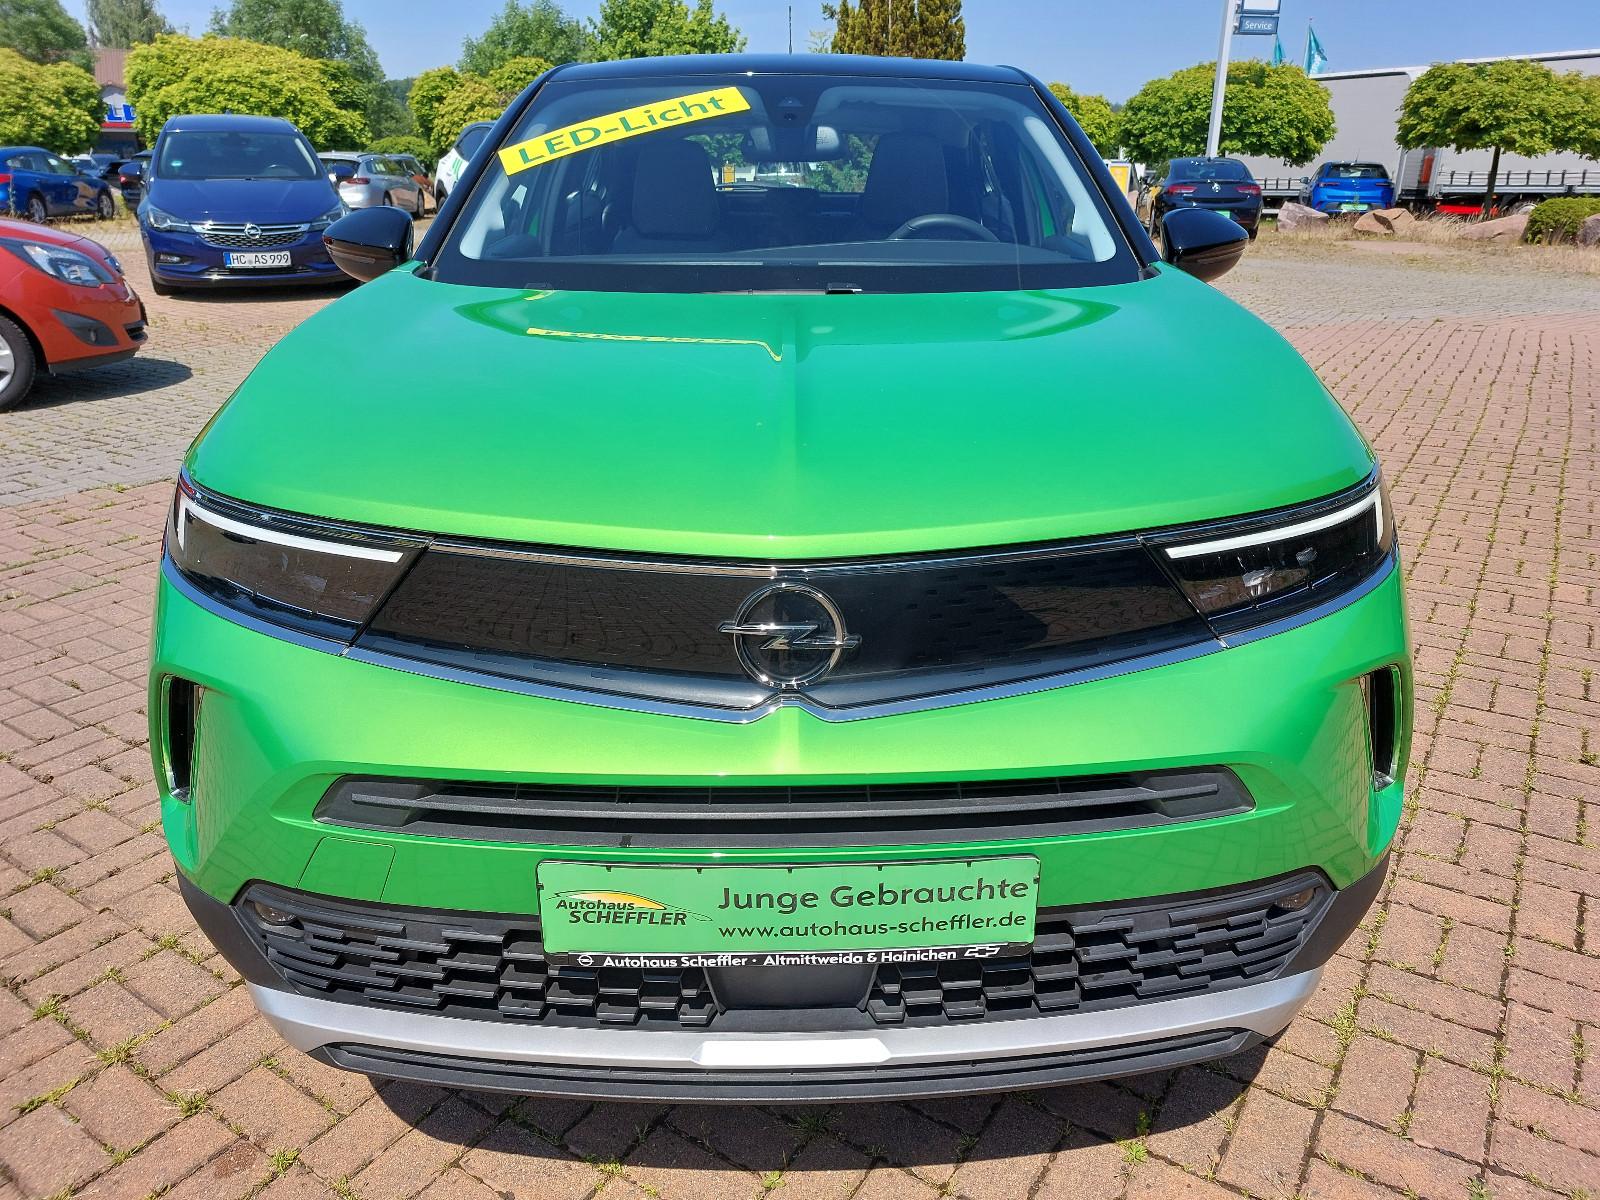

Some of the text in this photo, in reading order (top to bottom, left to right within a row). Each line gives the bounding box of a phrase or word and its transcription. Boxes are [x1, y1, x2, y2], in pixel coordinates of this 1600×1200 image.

[1245, 20, 1273, 30] Service
[518, 96, 726, 165] LED-Licht
[231, 253, 289, 265] HC AS 999
[718, 878, 1029, 914] Junge Gebrauchte
[556, 899, 635, 911] Autohaus
[568, 910, 688, 926] SCHEFFLER
[718, 911, 1027, 938] www.autohaus-scheffler.de
[603, 949, 957, 968] Autohaus Scheffler Altmittweida & Hainichen
